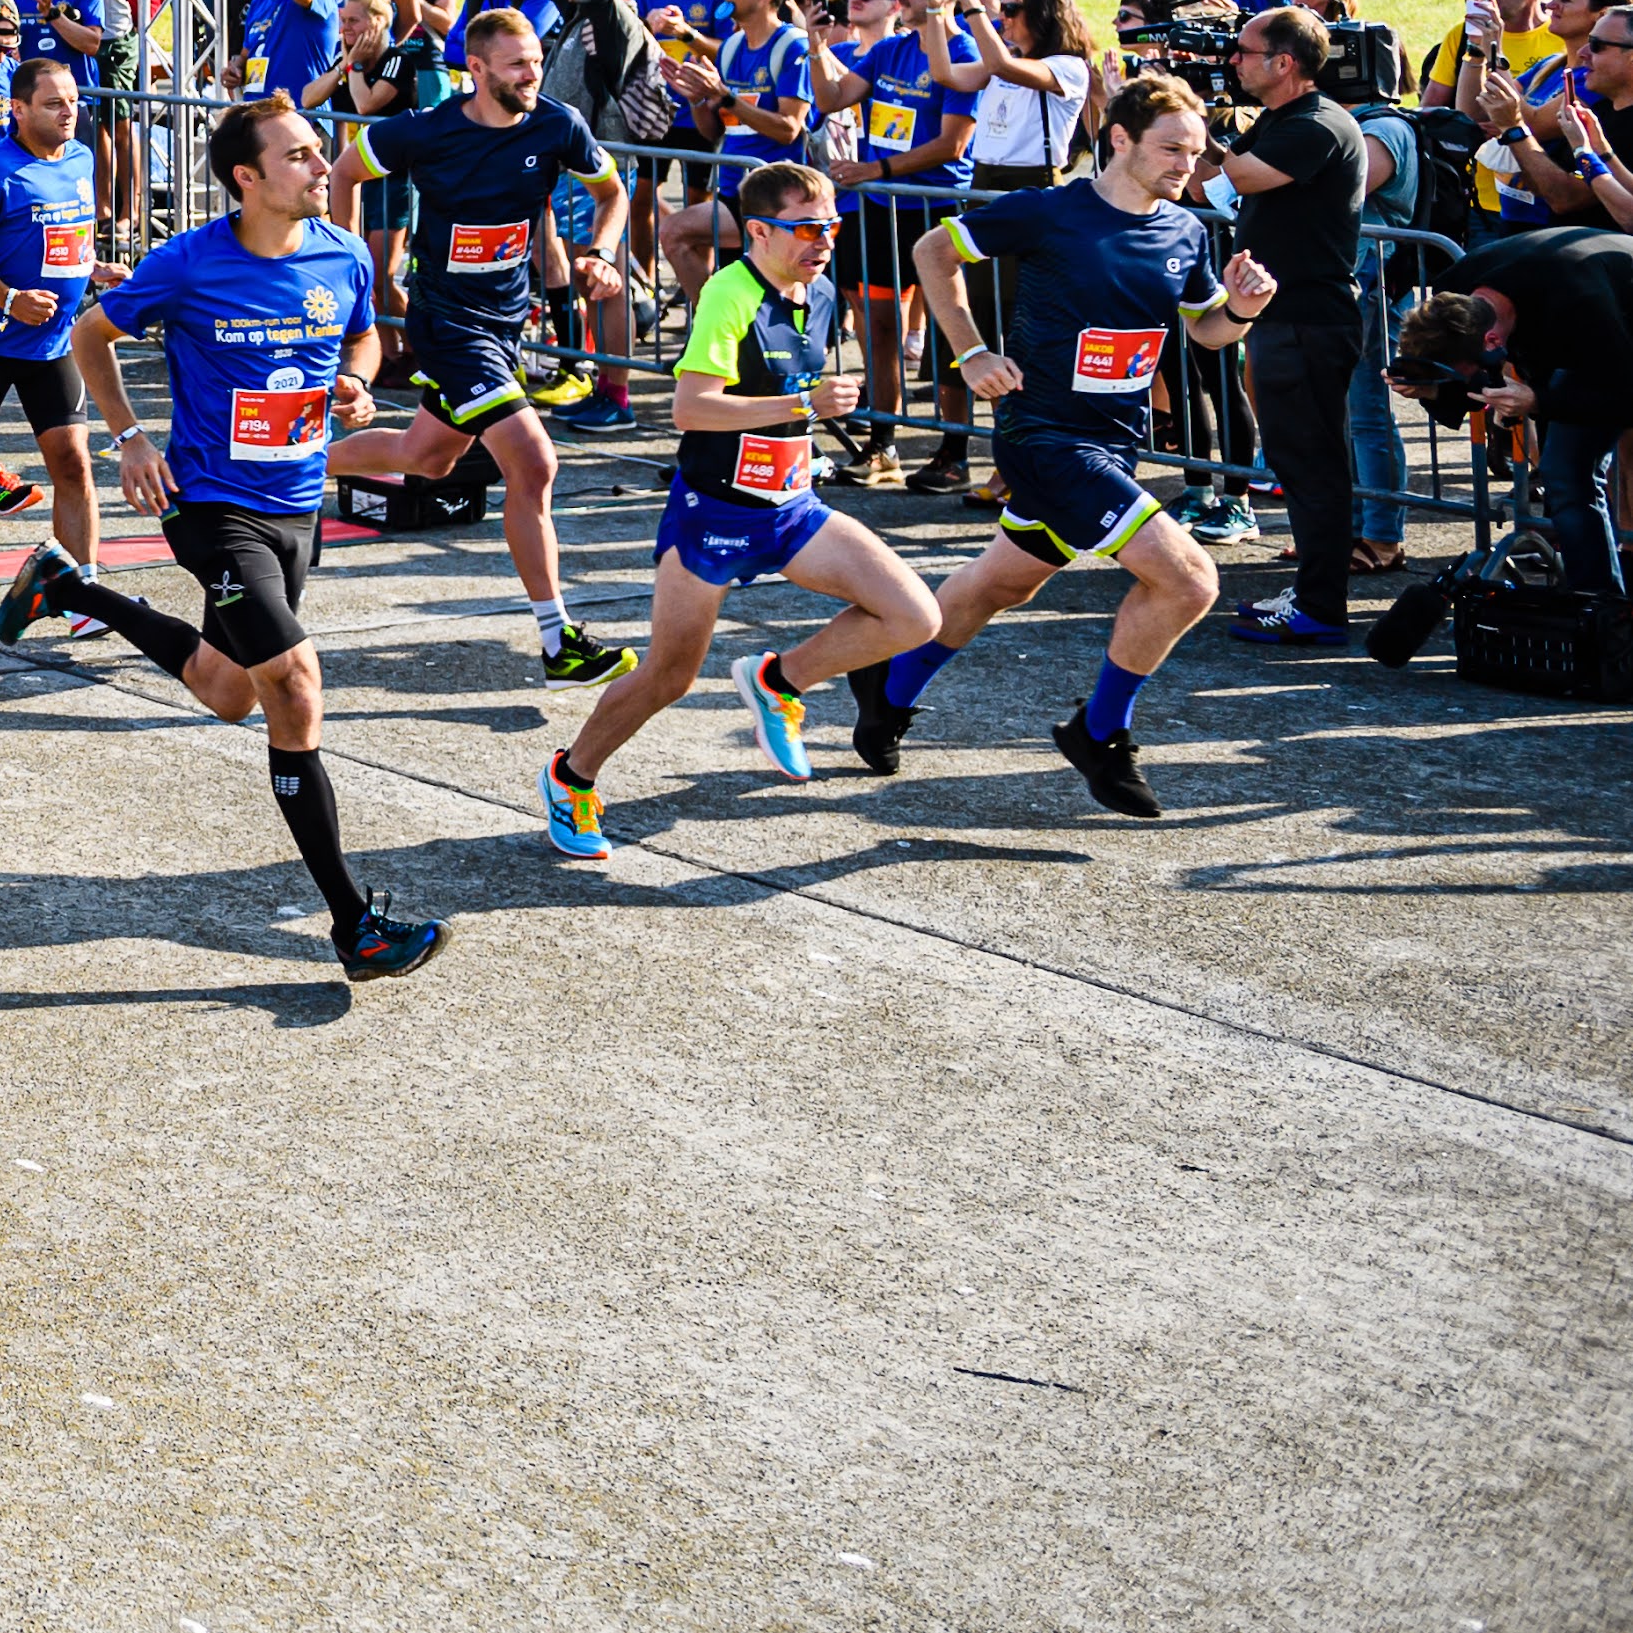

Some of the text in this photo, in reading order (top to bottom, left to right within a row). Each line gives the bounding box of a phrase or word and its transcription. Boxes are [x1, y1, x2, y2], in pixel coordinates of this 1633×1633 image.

[31, 211, 52, 223] Kom
[215, 322, 344, 345] Kom op tegen Kanker
[1083, 354, 1114, 367] #441
[273, 377, 299, 390] 2021
[239, 407, 258, 417] TIM
[238, 419, 270, 433] #194
[744, 451, 773, 463] KEVIN
